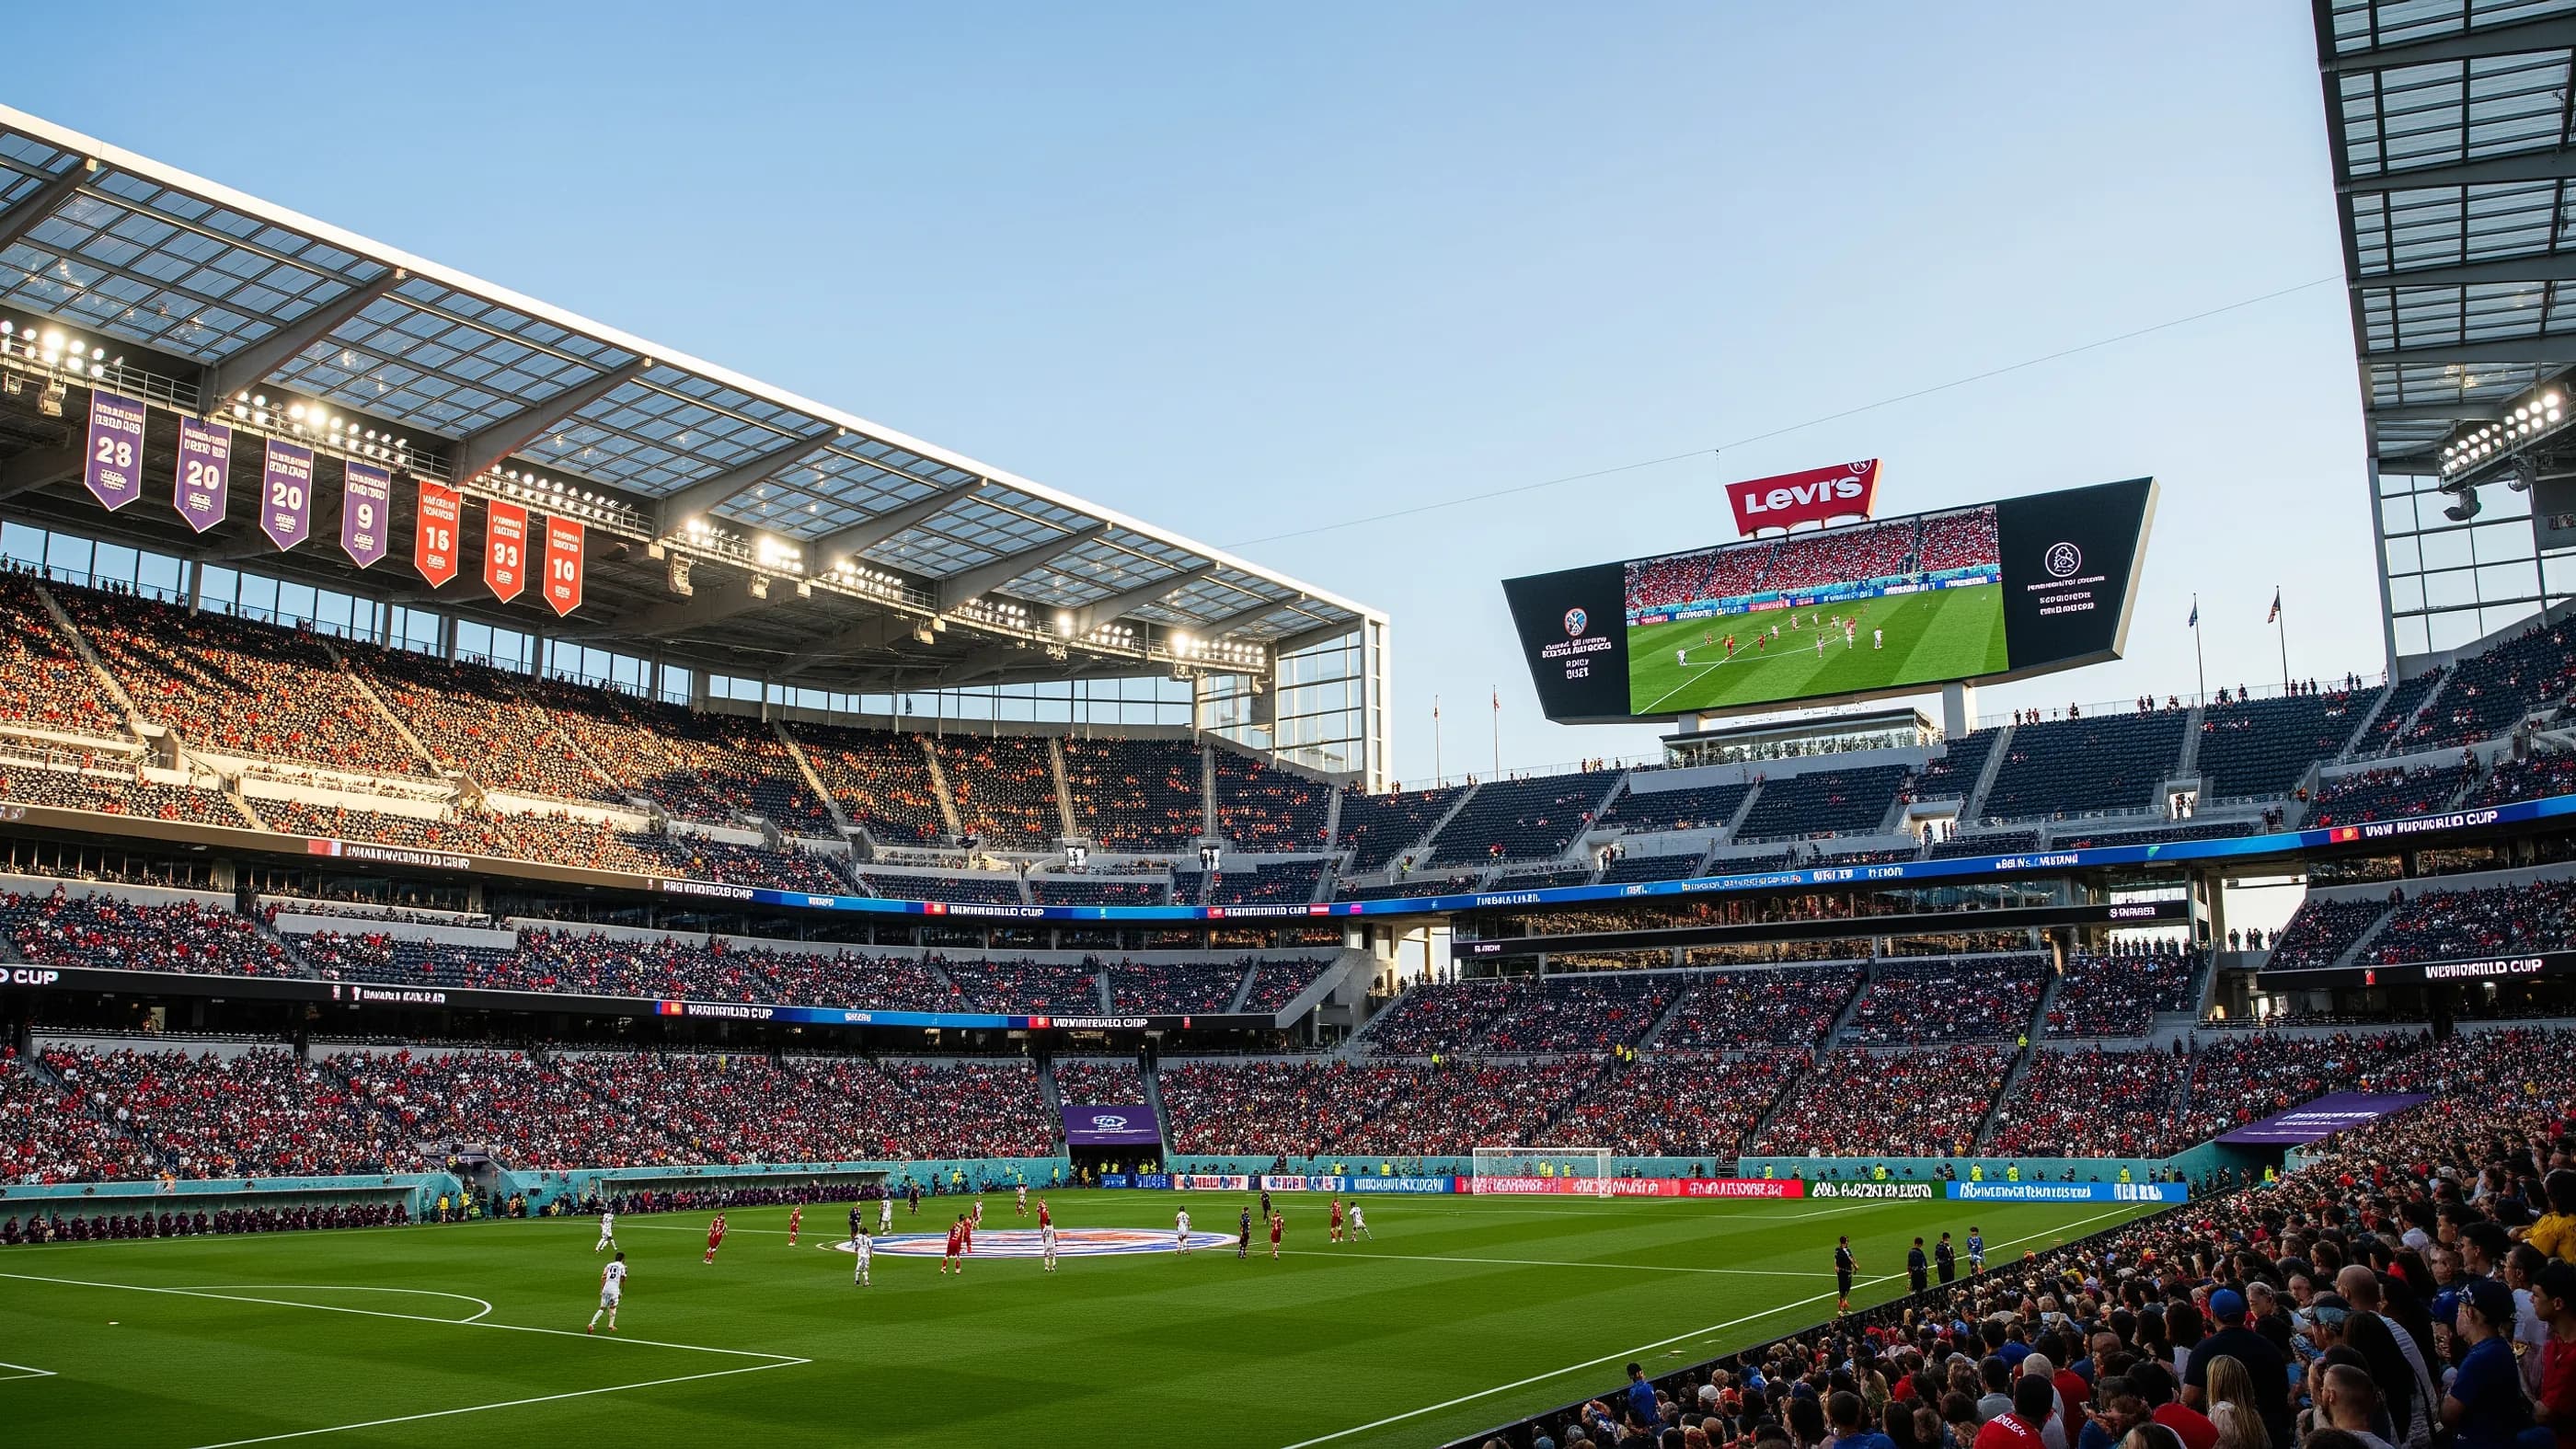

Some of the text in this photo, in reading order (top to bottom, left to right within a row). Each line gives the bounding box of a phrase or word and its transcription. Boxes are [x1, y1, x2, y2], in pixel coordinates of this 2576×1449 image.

[96, 436, 132, 467] 28
[187, 460, 220, 489] 20
[271, 482, 303, 511] 20
[357, 503, 374, 529] 9
[553, 558, 574, 581] 10
[2467, 811, 2498, 824] CUP
[1020, 907, 1044, 917] CUP
[2510, 959, 2543, 972] CUP
[13, 969, 60, 984] CUP
[751, 1007, 773, 1019] CUP
